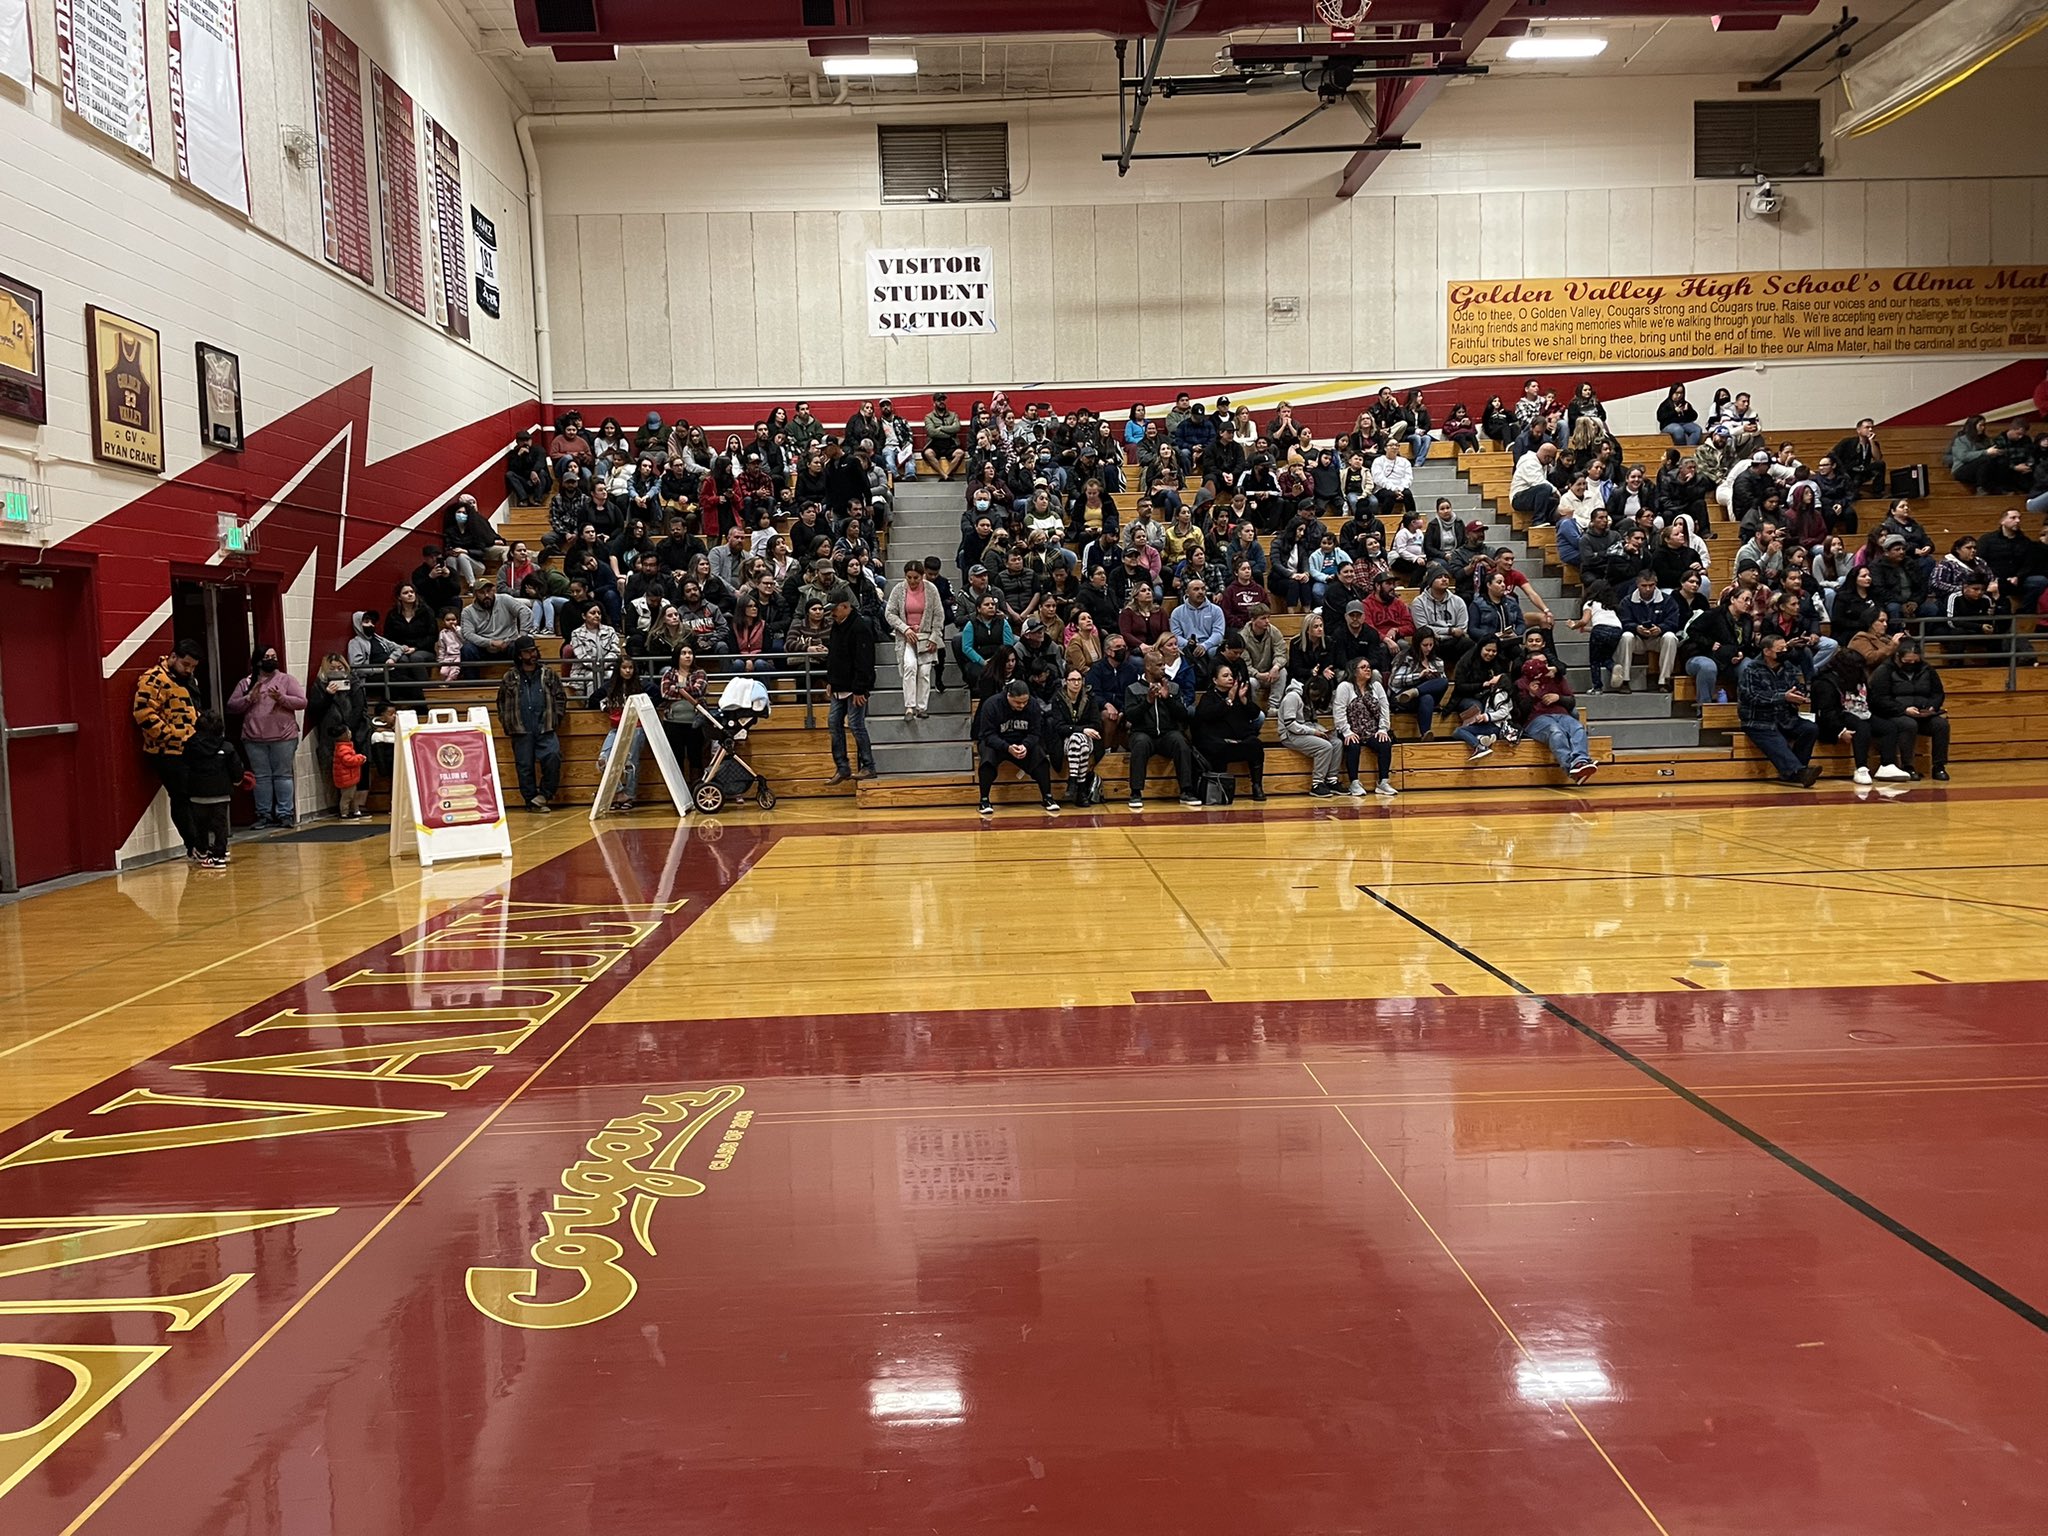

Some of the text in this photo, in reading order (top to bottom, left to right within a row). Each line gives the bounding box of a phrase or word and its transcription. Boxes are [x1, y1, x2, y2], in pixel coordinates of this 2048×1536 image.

[168, 45, 189, 180] GOLDEN
[878, 256, 982, 275] VISITOR
[873, 283, 989, 303] STUDENT
[1450, 284, 1554, 311] Golden
[1564, 280, 1667, 305] Valley
[1676, 276, 1754, 303] High
[1763, 272, 1882, 296] School's
[1893, 271, 1976, 292] Alma
[878, 310, 986, 330] SECTION
[1453, 309, 1475, 322] Ode
[1477, 309, 1487, 321] to
[1518, 307, 1528, 320] O
[1530, 306, 1567, 320] Golden
[1607, 304, 1651, 319] Cougars
[1653, 304, 1686, 318] strong
[1688, 302, 1707, 314] and
[1710, 301, 1754, 316] Cougars
[1756, 301, 1779, 312] true.
[1781, 299, 1811, 312] Raise
[1813, 300, 1831, 311] our
[1833, 298, 1865, 310] voices
[1868, 298, 1888, 309] and
[1890, 298, 1906, 308] our
[12, 320, 24, 340] 12
[1451, 323, 1485, 337] Making
[1487, 321, 1518, 334] friends
[1520, 321, 1538, 333] and
[1540, 320, 1574, 334] making
[1576, 319, 1621, 332] memories
[1624, 317, 1647, 330] while
[1650, 316, 1674, 329] we're
[1677, 315, 1711, 331] walking
[1714, 314, 1749, 329] through
[1751, 315, 1772, 328] your
[1774, 312, 1797, 325] halls.
[1803, 311, 1829, 324] We're
[1832, 310, 1876, 325] accepting
[1878, 310, 1903, 324] every
[1905, 309, 1949, 323] challenge
[1450, 337, 1488, 350] Faithful
[1492, 336, 1531, 348] tributes
[1534, 336, 1549, 348] we
[1552, 334, 1577, 346] shall
[1580, 333, 1607, 347] bring
[1610, 332, 1636, 345] thee,
[1640, 331, 1666, 346] bring
[1669, 331, 1692, 343] until
[1695, 330, 1711, 342] the
[1714, 329, 1734, 341] end
[1737, 327, 1749, 340] of
[1750, 327, 1776, 340] time.
[1782, 326, 1800, 339] We
[1803, 325, 1820, 338] will
[1823, 325, 1841, 338] live
[1844, 325, 1864, 337] and
[1867, 324, 1894, 336] learn
[1896, 324, 1906, 336] in
[1909, 323, 1954, 337] harmony
[1957, 323, 1968, 335] at
[1970, 321, 2008, 334] Golden
[1451, 352, 1496, 366] Cougars
[1499, 350, 1524, 362] shall
[1526, 349, 1563, 361] forever
[1566, 348, 1596, 363] reign,
[1600, 348, 1613, 360] be
[1616, 346, 1666, 359] victorious
[1669, 344, 1689, 356] and
[1692, 344, 1718, 356] bold.
[1724, 343, 1745, 355] Hail
[1747, 342, 1758, 354] to
[1760, 341, 1784, 354] thee
[1786, 342, 1804, 353] our
[1806, 340, 1834, 353] Alma
[1837, 340, 1870, 354] Mater,
[1872, 338, 1892, 351] hail
[1894, 338, 1911, 350] the
[1913, 337, 1956, 350] cardinal
[1958, 336, 1978, 348] and
[118, 405, 142, 426] VALLEY
[125, 429, 138, 443] GV
[104, 441, 157, 466] RYAN CRANE
[439, 771, 468, 780] FOLLOW US
[0, 898, 689, 1171] VALLEY
[723, 1129, 745, 1142] OF
[708, 1141, 740, 1171] CLASS
[465, 1084, 746, 1329] Cougars
